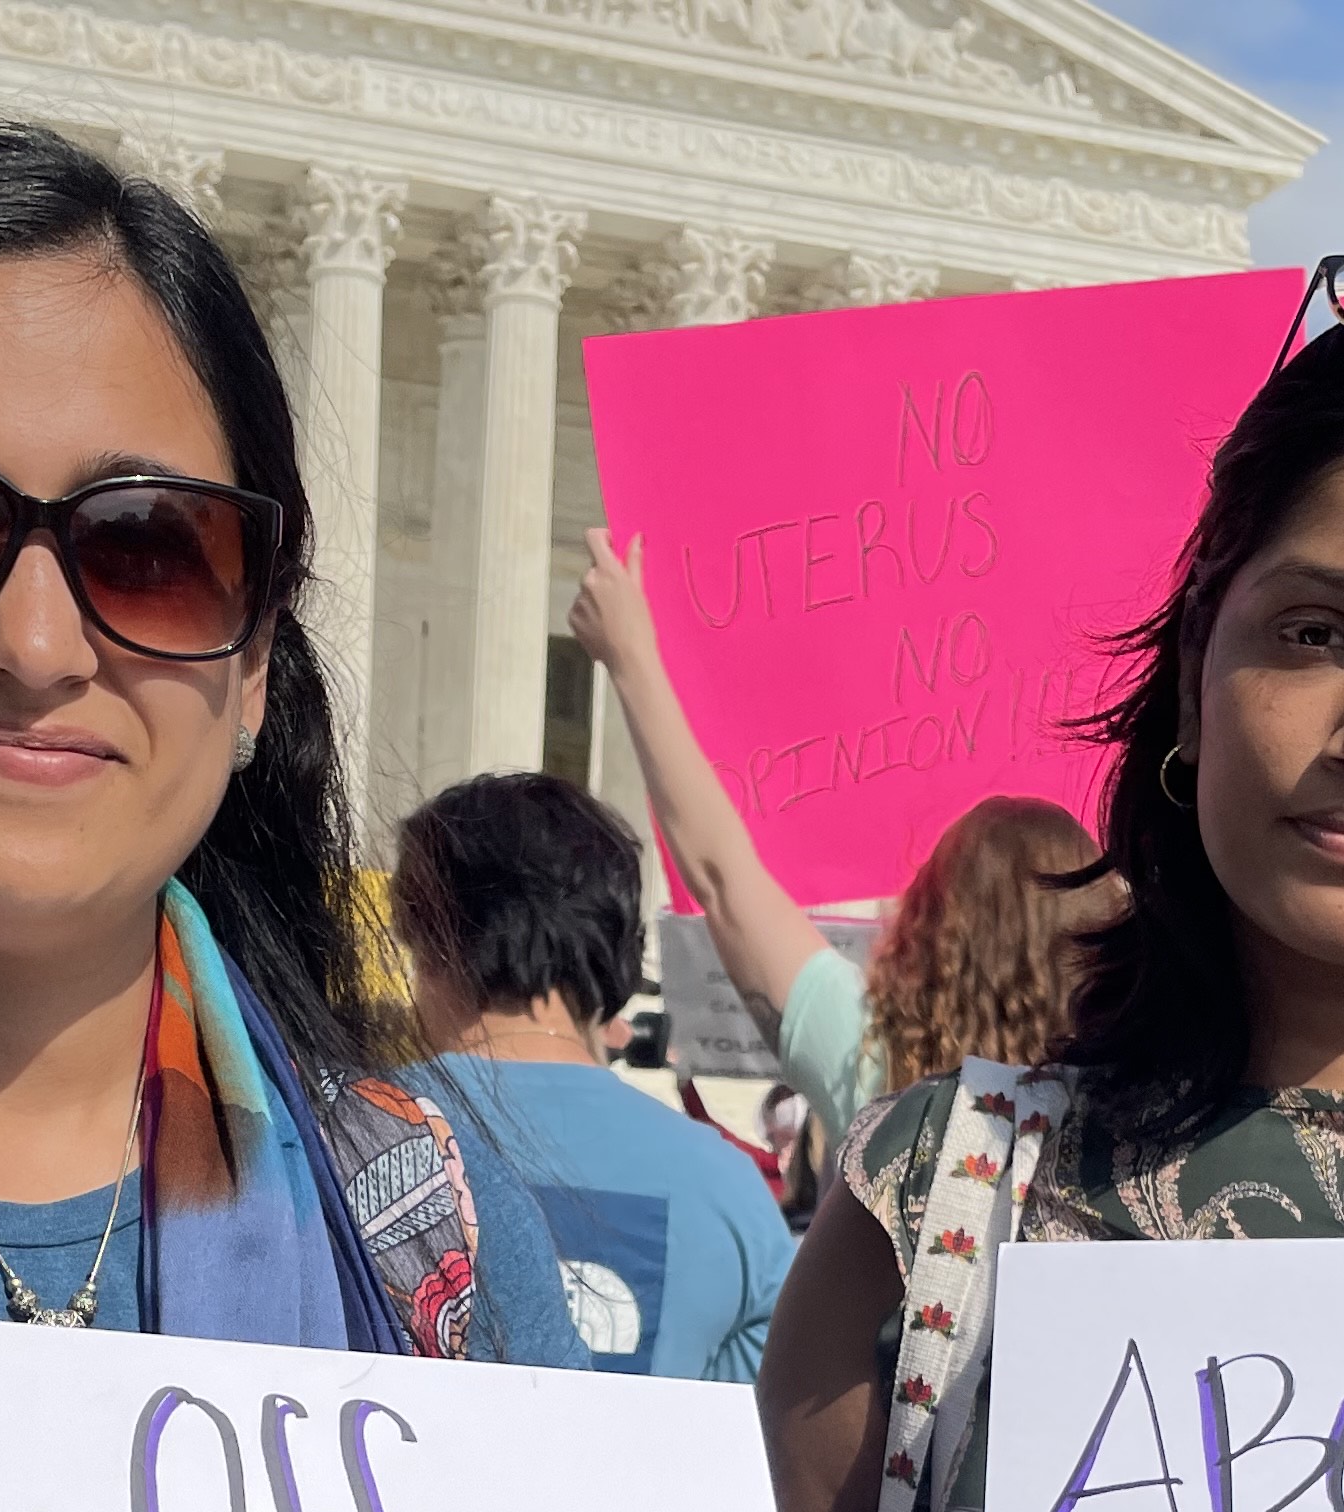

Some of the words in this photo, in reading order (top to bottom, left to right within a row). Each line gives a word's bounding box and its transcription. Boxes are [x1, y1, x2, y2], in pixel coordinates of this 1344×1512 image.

[384, 78, 513, 127] EQUAL
[523, 97, 661, 153] JUSTICE
[678, 124, 795, 178] UNDER
[898, 370, 996, 488] NO
[683, 491, 1001, 629] UTERUS
[893, 611, 992, 703] NO
